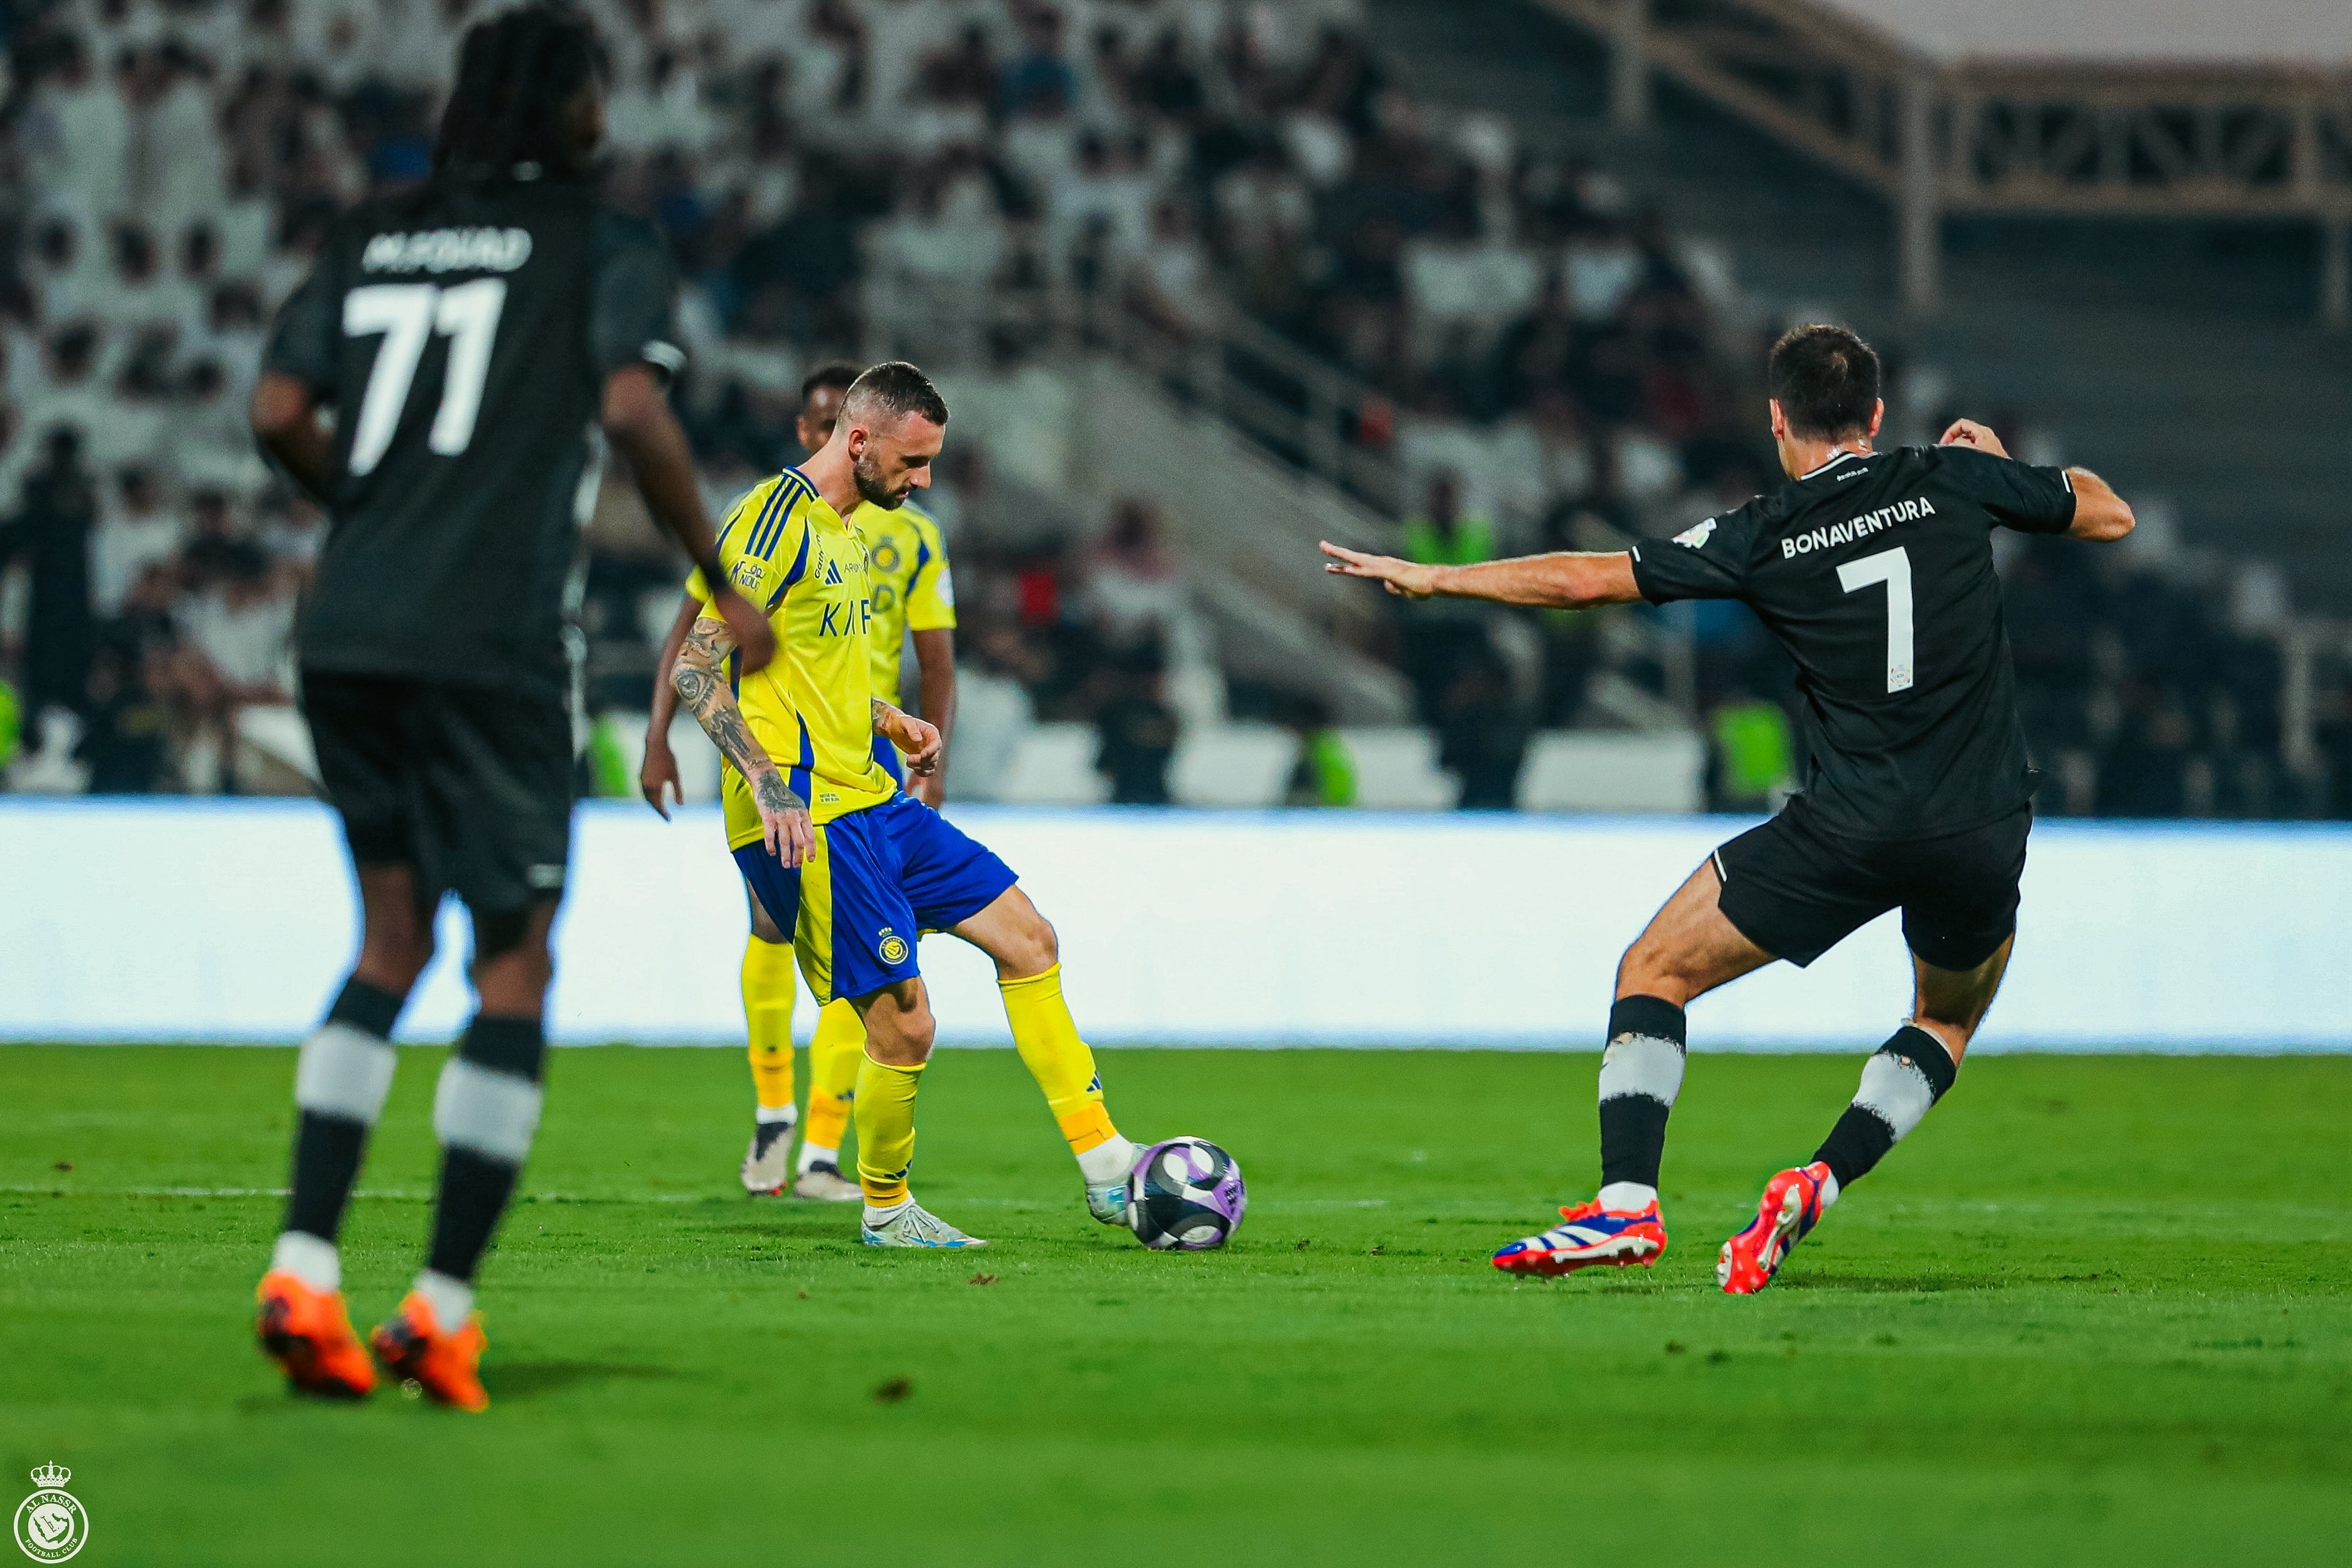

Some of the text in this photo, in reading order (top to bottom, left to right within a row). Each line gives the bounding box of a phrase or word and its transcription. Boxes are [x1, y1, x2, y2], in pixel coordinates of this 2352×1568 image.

[343, 278, 508, 476] 71
[1782, 497, 1935, 560] BONAVENTURA
[1835, 546, 1913, 693] 7
